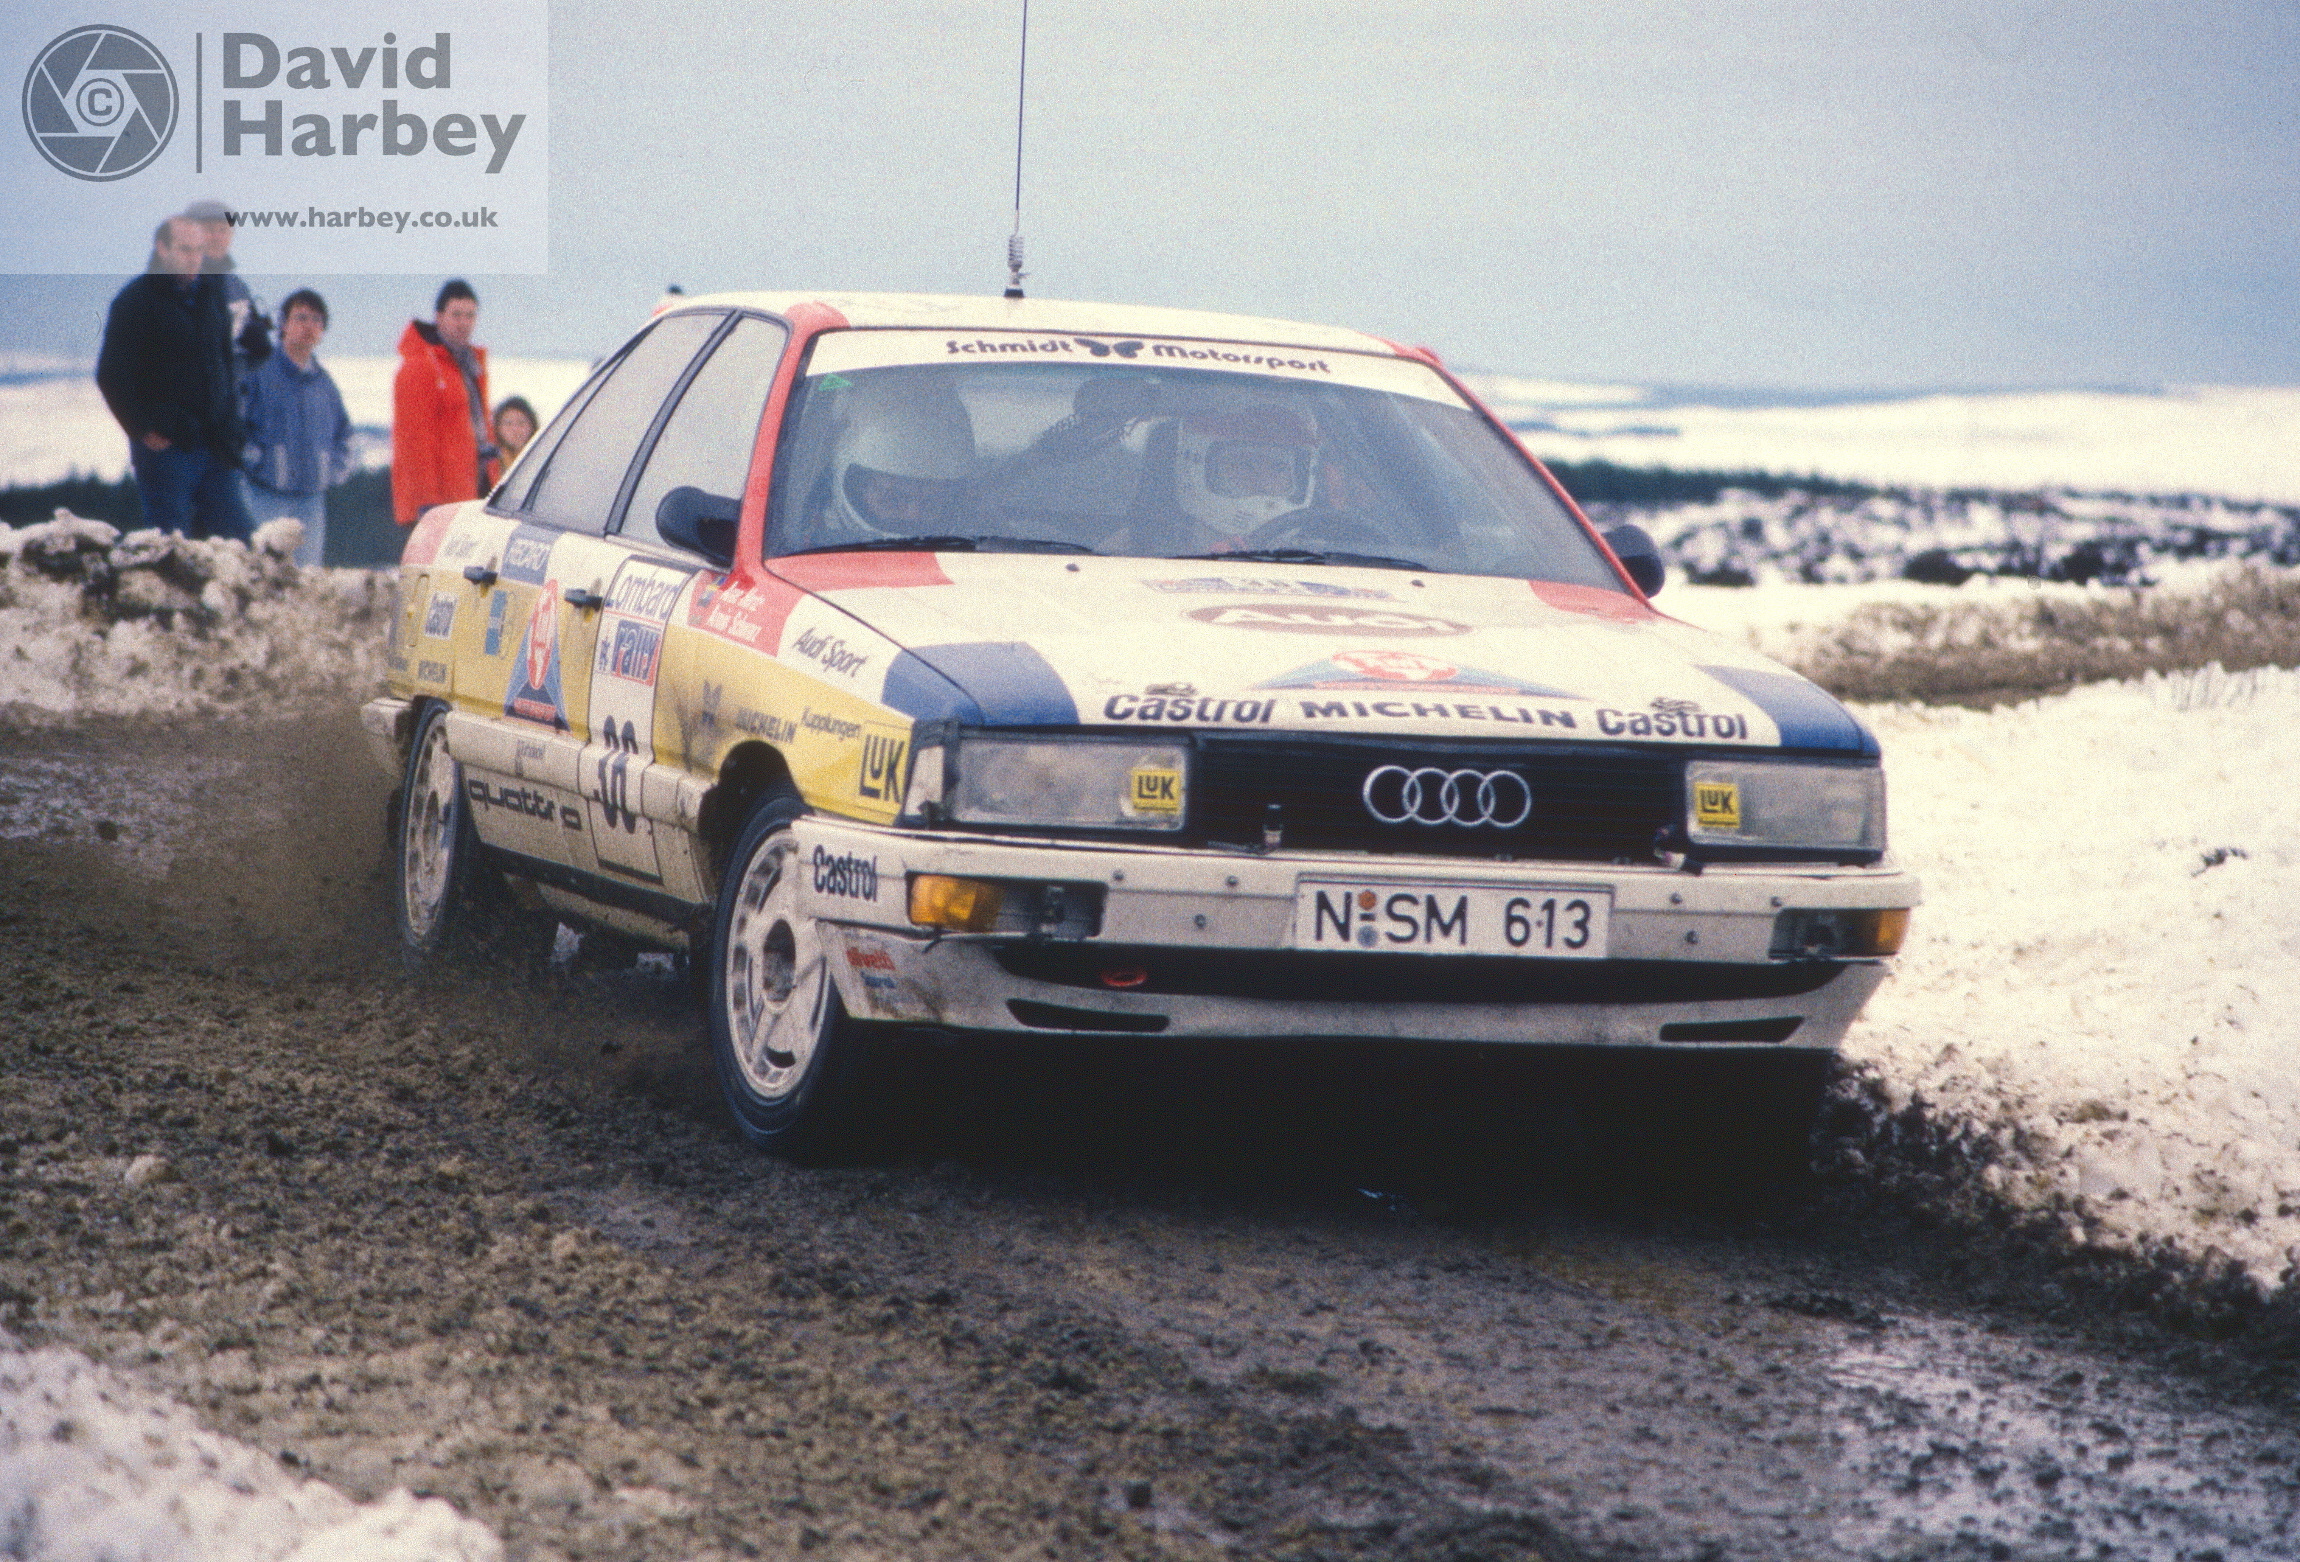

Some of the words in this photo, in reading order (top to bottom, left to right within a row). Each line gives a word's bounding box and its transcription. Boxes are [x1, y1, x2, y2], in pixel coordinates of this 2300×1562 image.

[946, 339, 1073, 355] Schmidt
[1151, 344, 1331, 374] Motorsport
[1210, 608, 1462, 634] Audi
[792, 627, 827, 659] Audi
[819, 638, 869, 677] Sport
[1103, 694, 1277, 723] Castrol
[1300, 701, 1577, 729] MICHELIN
[1596, 708, 1748, 740] Castrol
[468, 779, 582, 831] quattro
[813, 845, 878, 902] Castrol
[1505, 897, 1591, 949] 613
